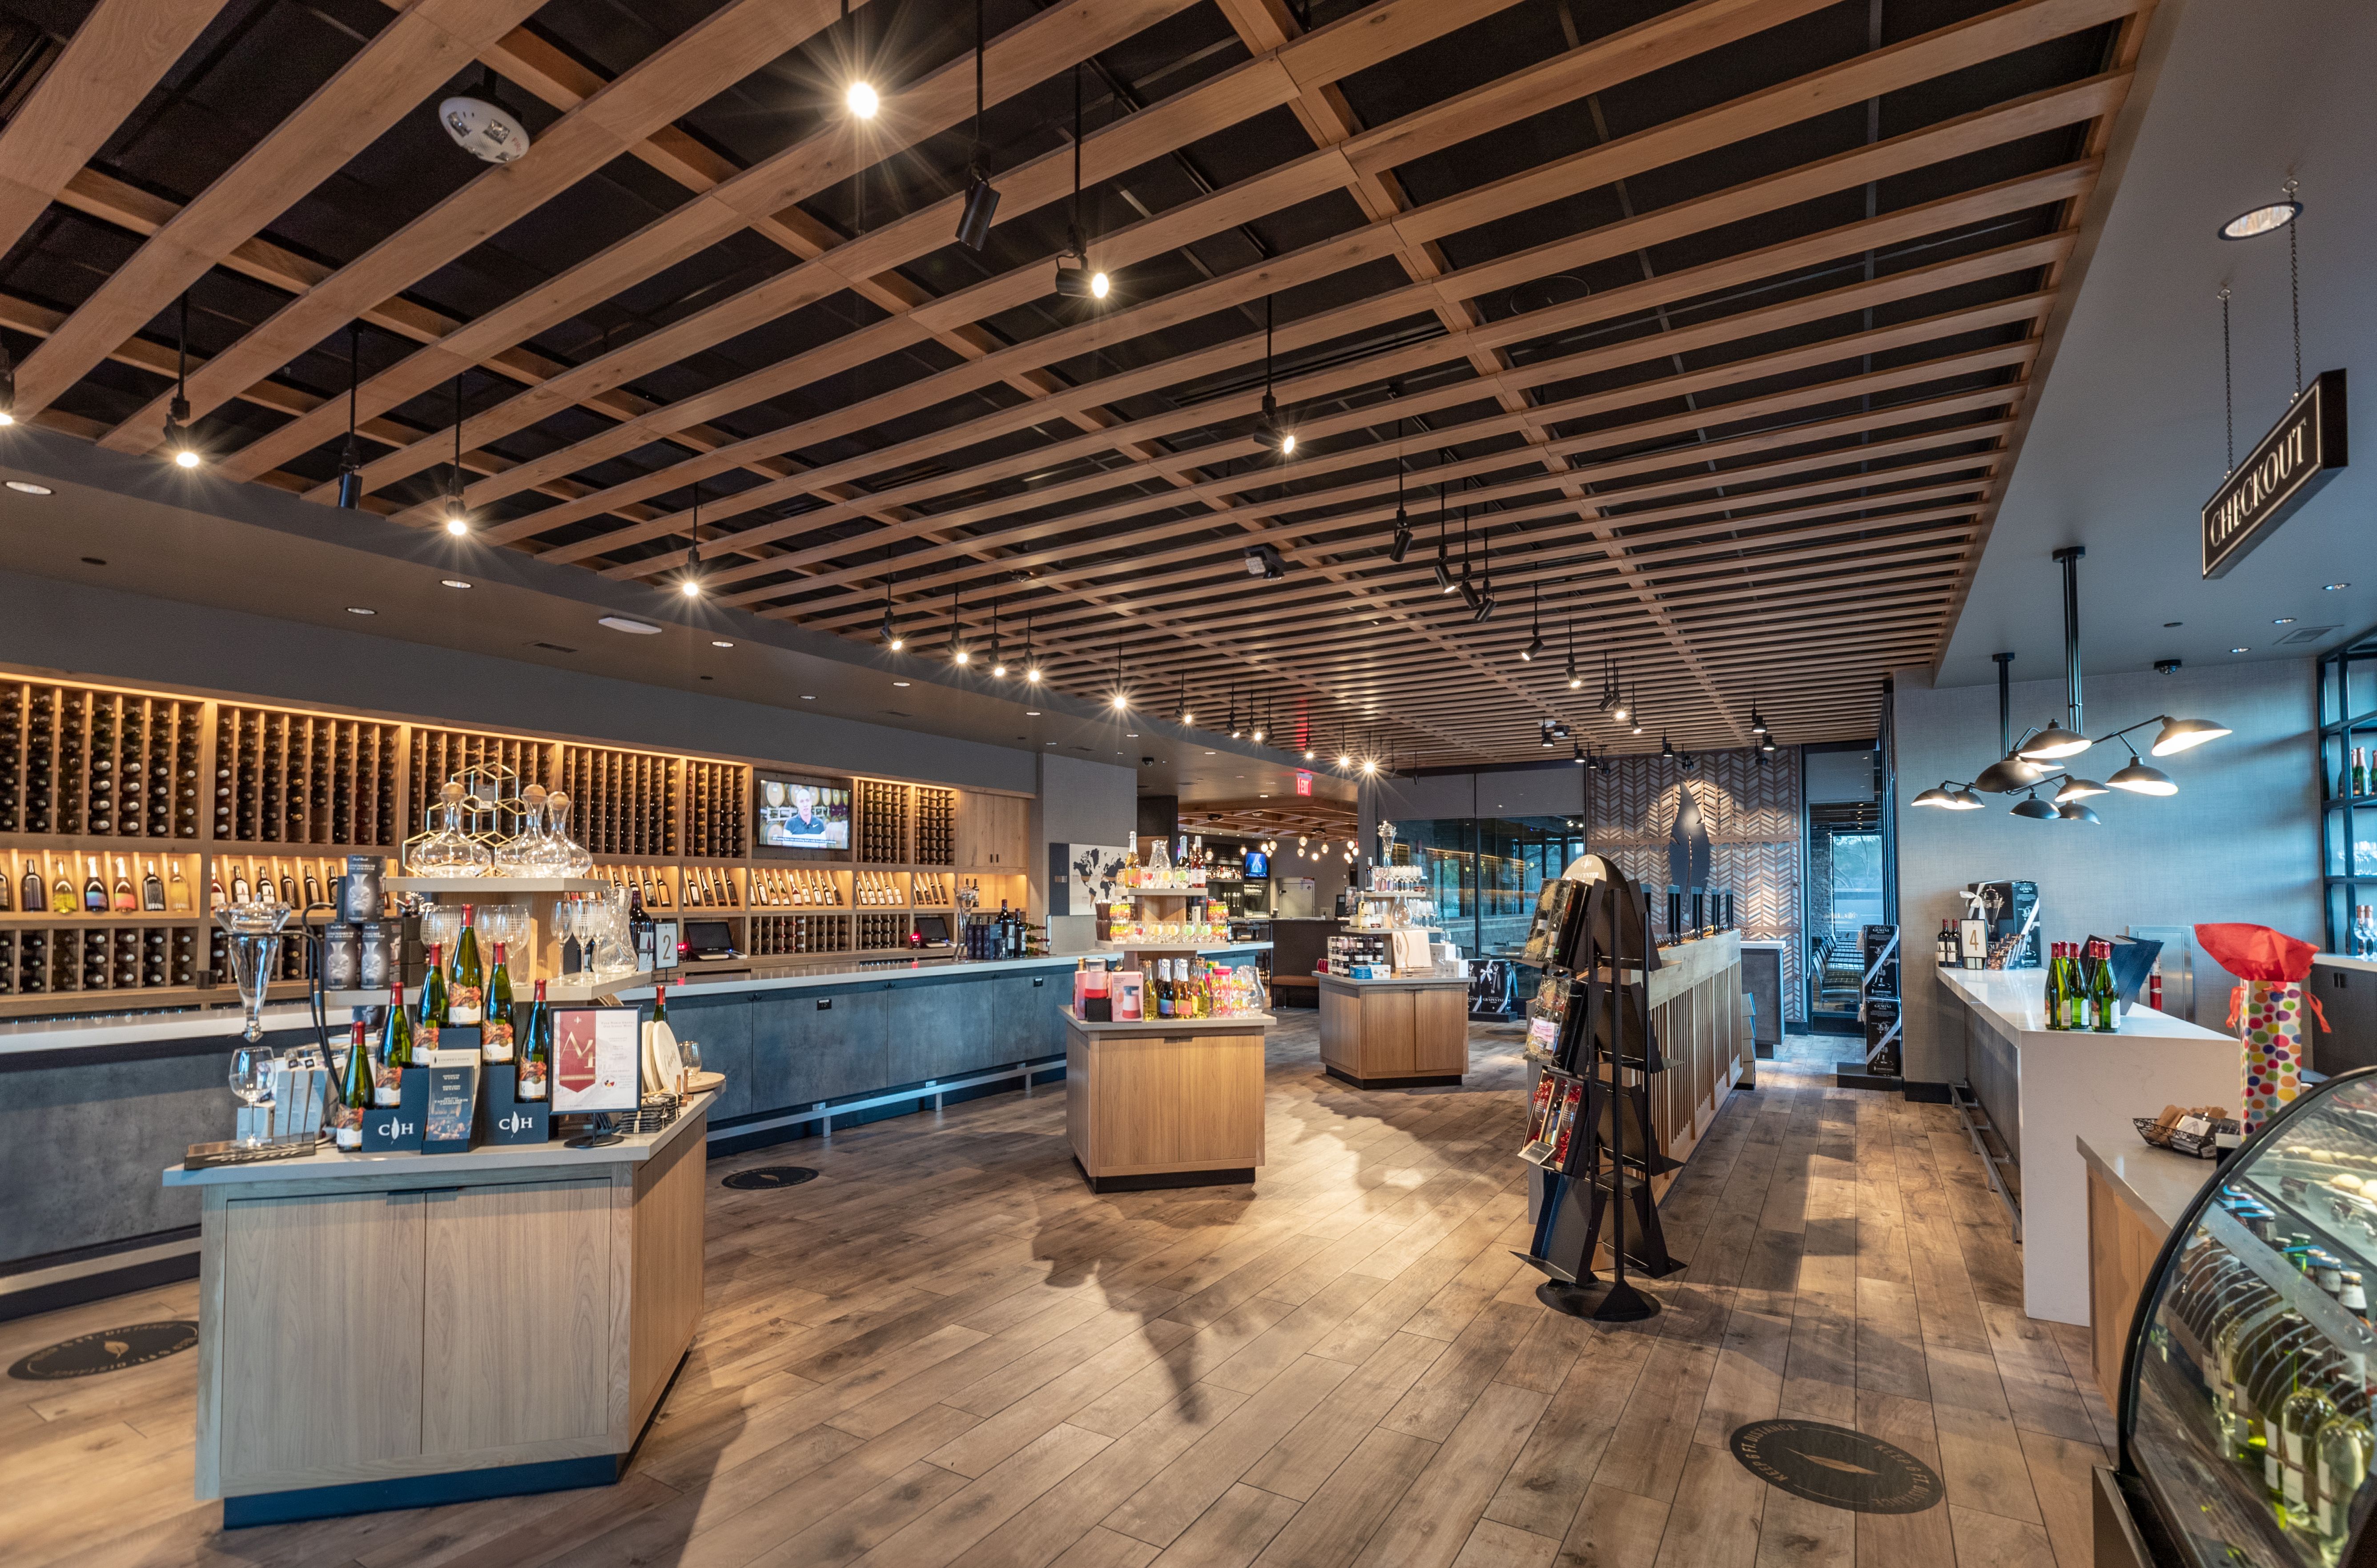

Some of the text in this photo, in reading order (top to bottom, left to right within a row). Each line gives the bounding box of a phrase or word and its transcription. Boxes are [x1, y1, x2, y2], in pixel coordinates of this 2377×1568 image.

[2210, 417, 2307, 547] CHECKOUT
[1301, 780, 1309, 794] EXIT
[663, 935, 671, 960] 2
[1969, 929, 1979, 951] 4
[1743, 1424, 1799, 1442] DISTANCE
[1741, 1443, 1757, 1453] FT.
[1874, 1445, 1912, 1464] KEEP
[1752, 1461, 1789, 1481] KEEP
[1870, 1484, 1929, 1508] DISTANCE
